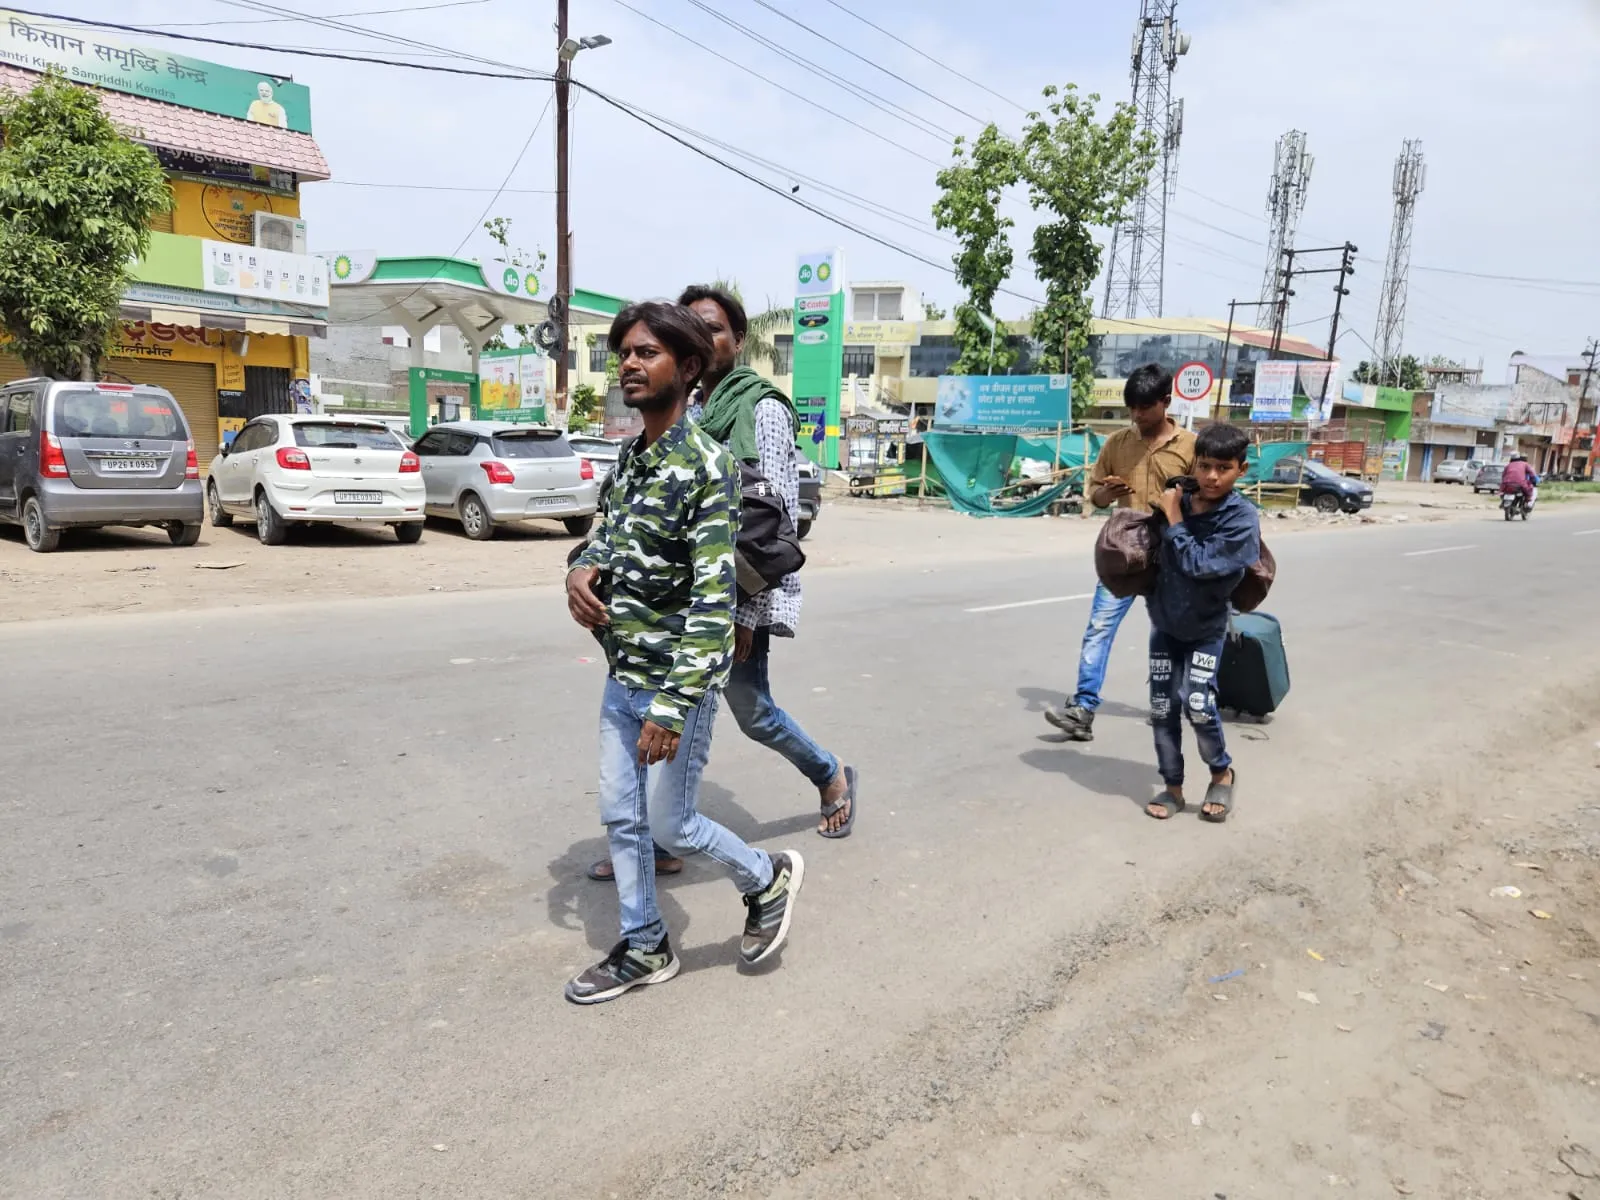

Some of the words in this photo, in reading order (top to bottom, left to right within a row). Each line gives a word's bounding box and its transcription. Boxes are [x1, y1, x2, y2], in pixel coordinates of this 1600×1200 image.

[8, 17, 85, 55] किसान
[93, 43, 159, 74] समृद्धि
[166, 57, 208, 86] केन्द्र
[71, 66, 132, 89] Samriddhi
[135, 80, 176, 99] Kendra
[800, 270, 811, 278] Jio
[806, 300, 829, 308] Castrol
[1188, 378, 1200, 387] 10
[1196, 654, 1214, 667] We
